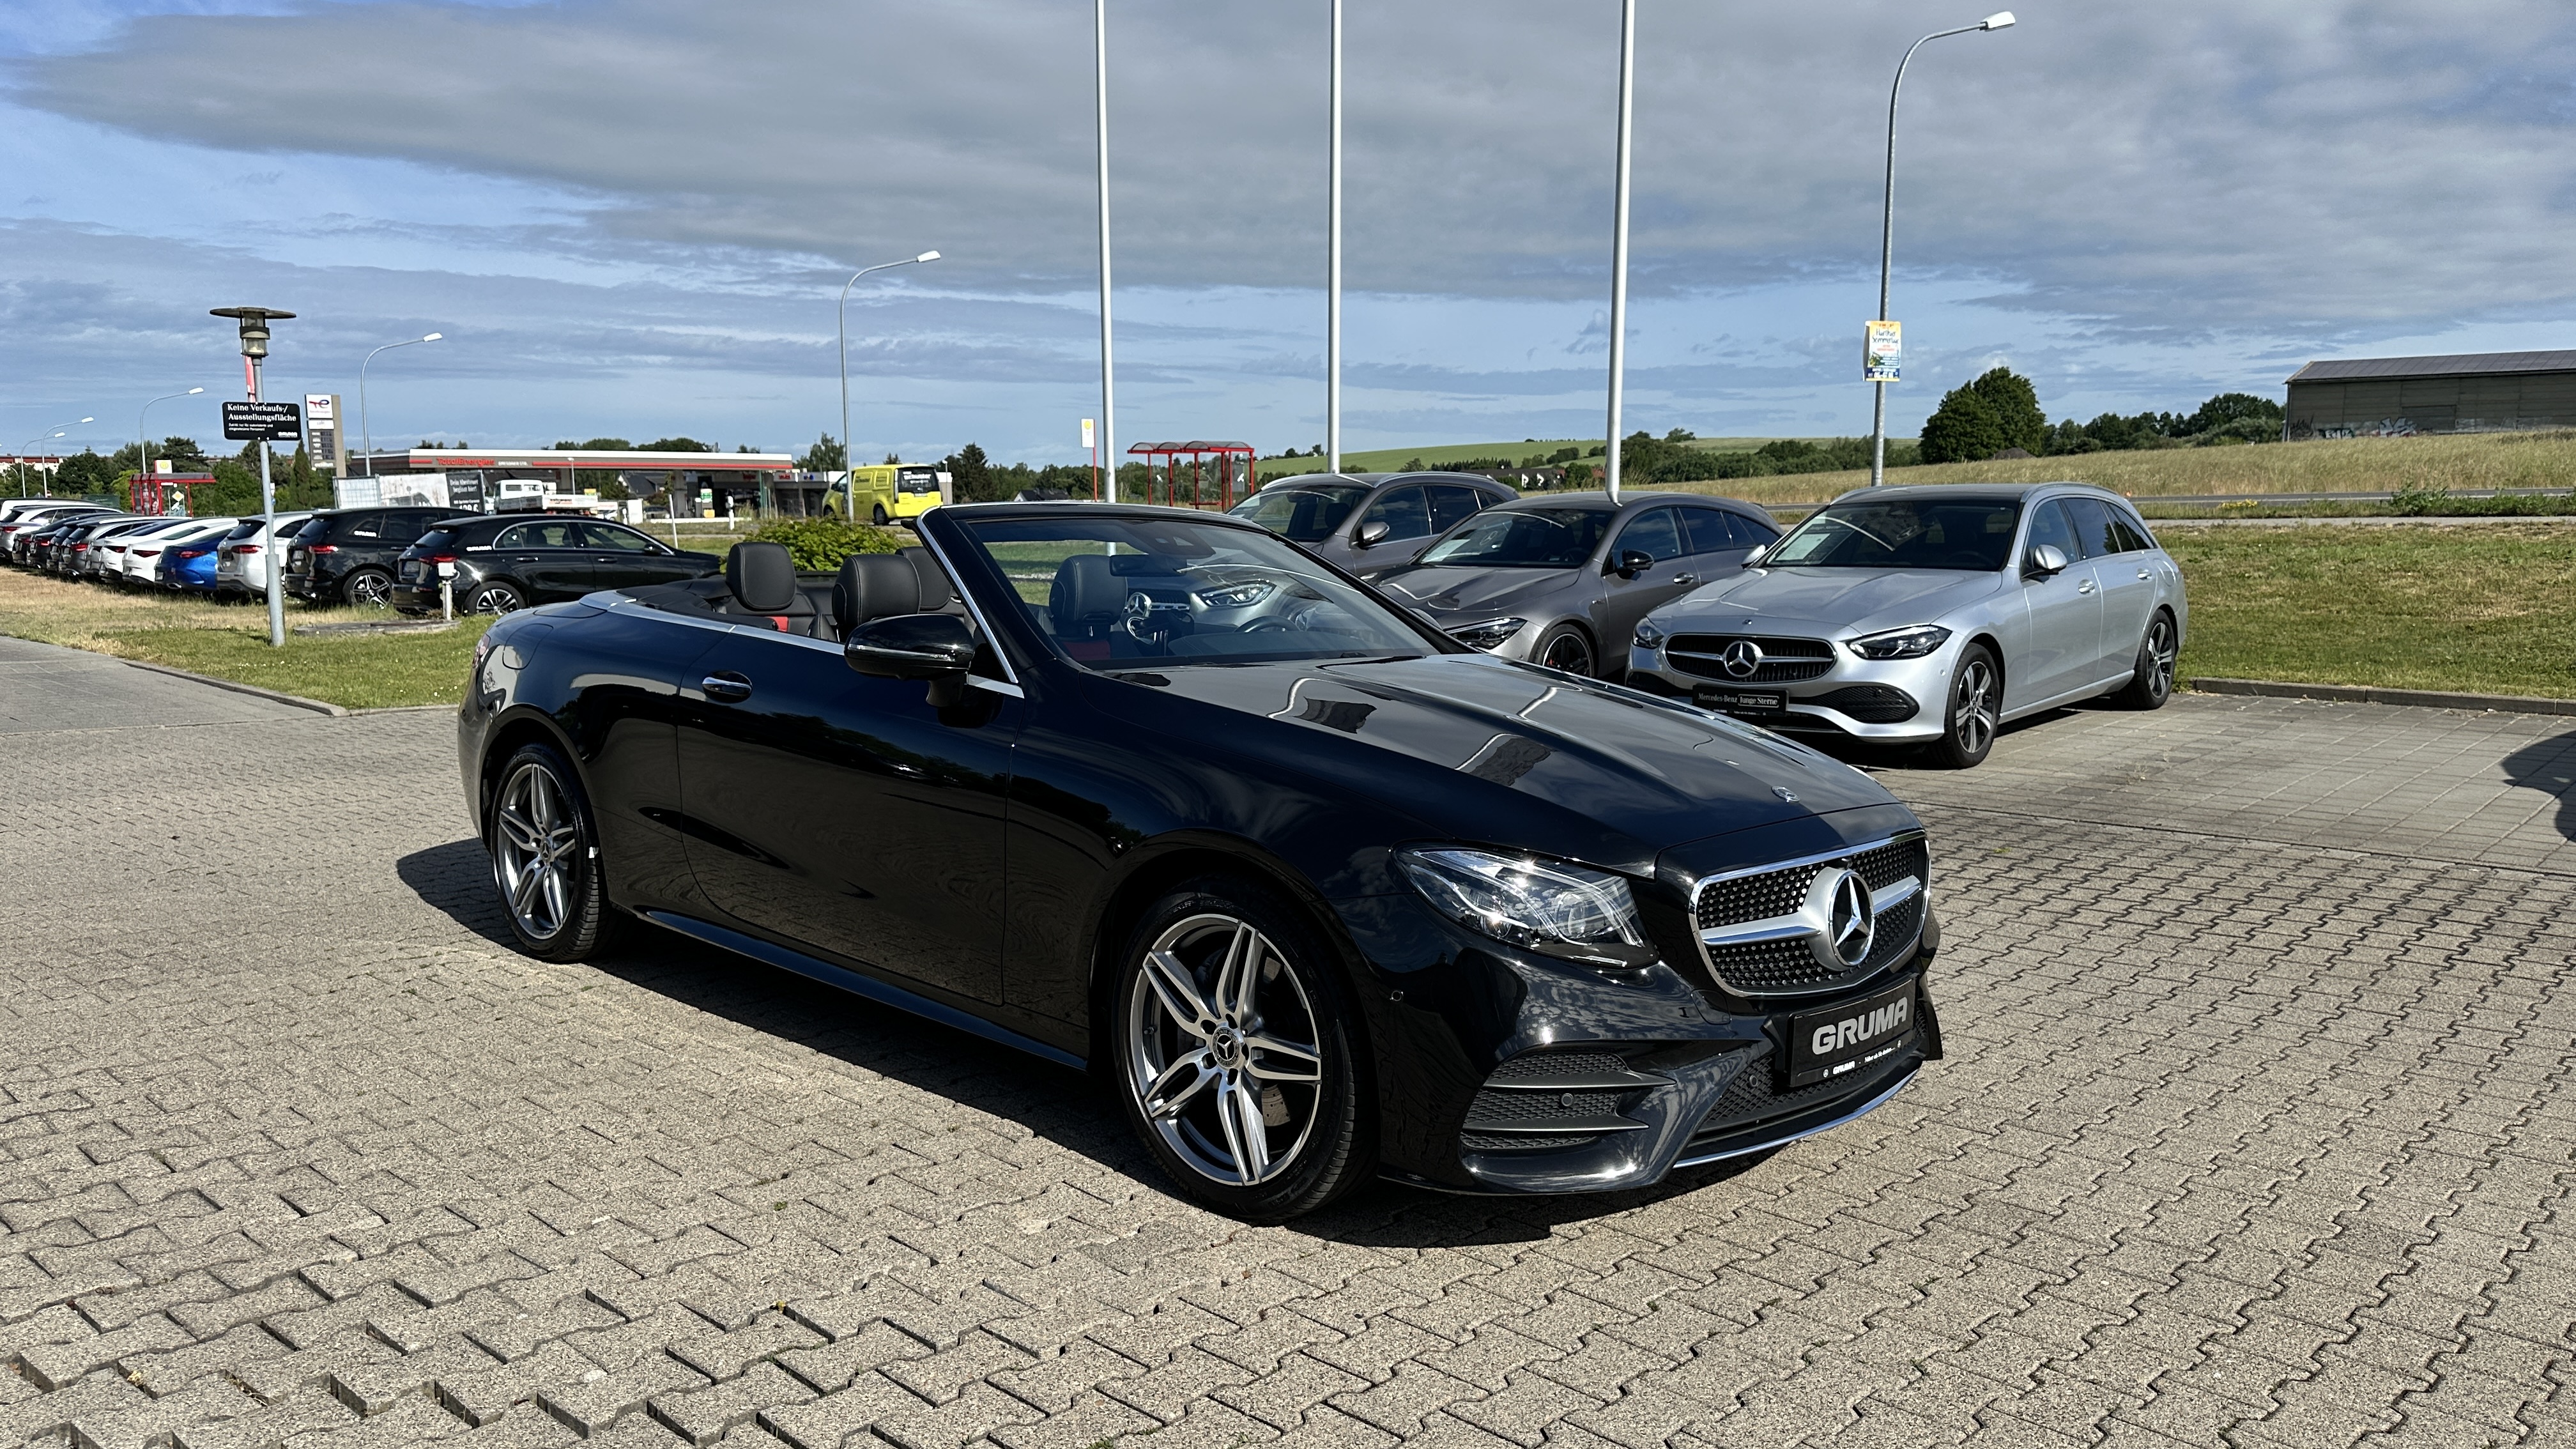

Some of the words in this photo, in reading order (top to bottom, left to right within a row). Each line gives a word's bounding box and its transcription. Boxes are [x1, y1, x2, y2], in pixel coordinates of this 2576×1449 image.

[251, 404, 288, 413] Verkaufs-/
[228, 413, 296, 422] Ausstellungsfläche
[436, 457, 494, 468] TotalEnergies
[1698, 693, 1738, 702] Mercedes-Benz
[1740, 696, 1756, 705] Junge
[1757, 697, 1778, 705] Sterne
[1812, 997, 1908, 1055] GRUMA
[1833, 1061, 1855, 1075] GRUMA
